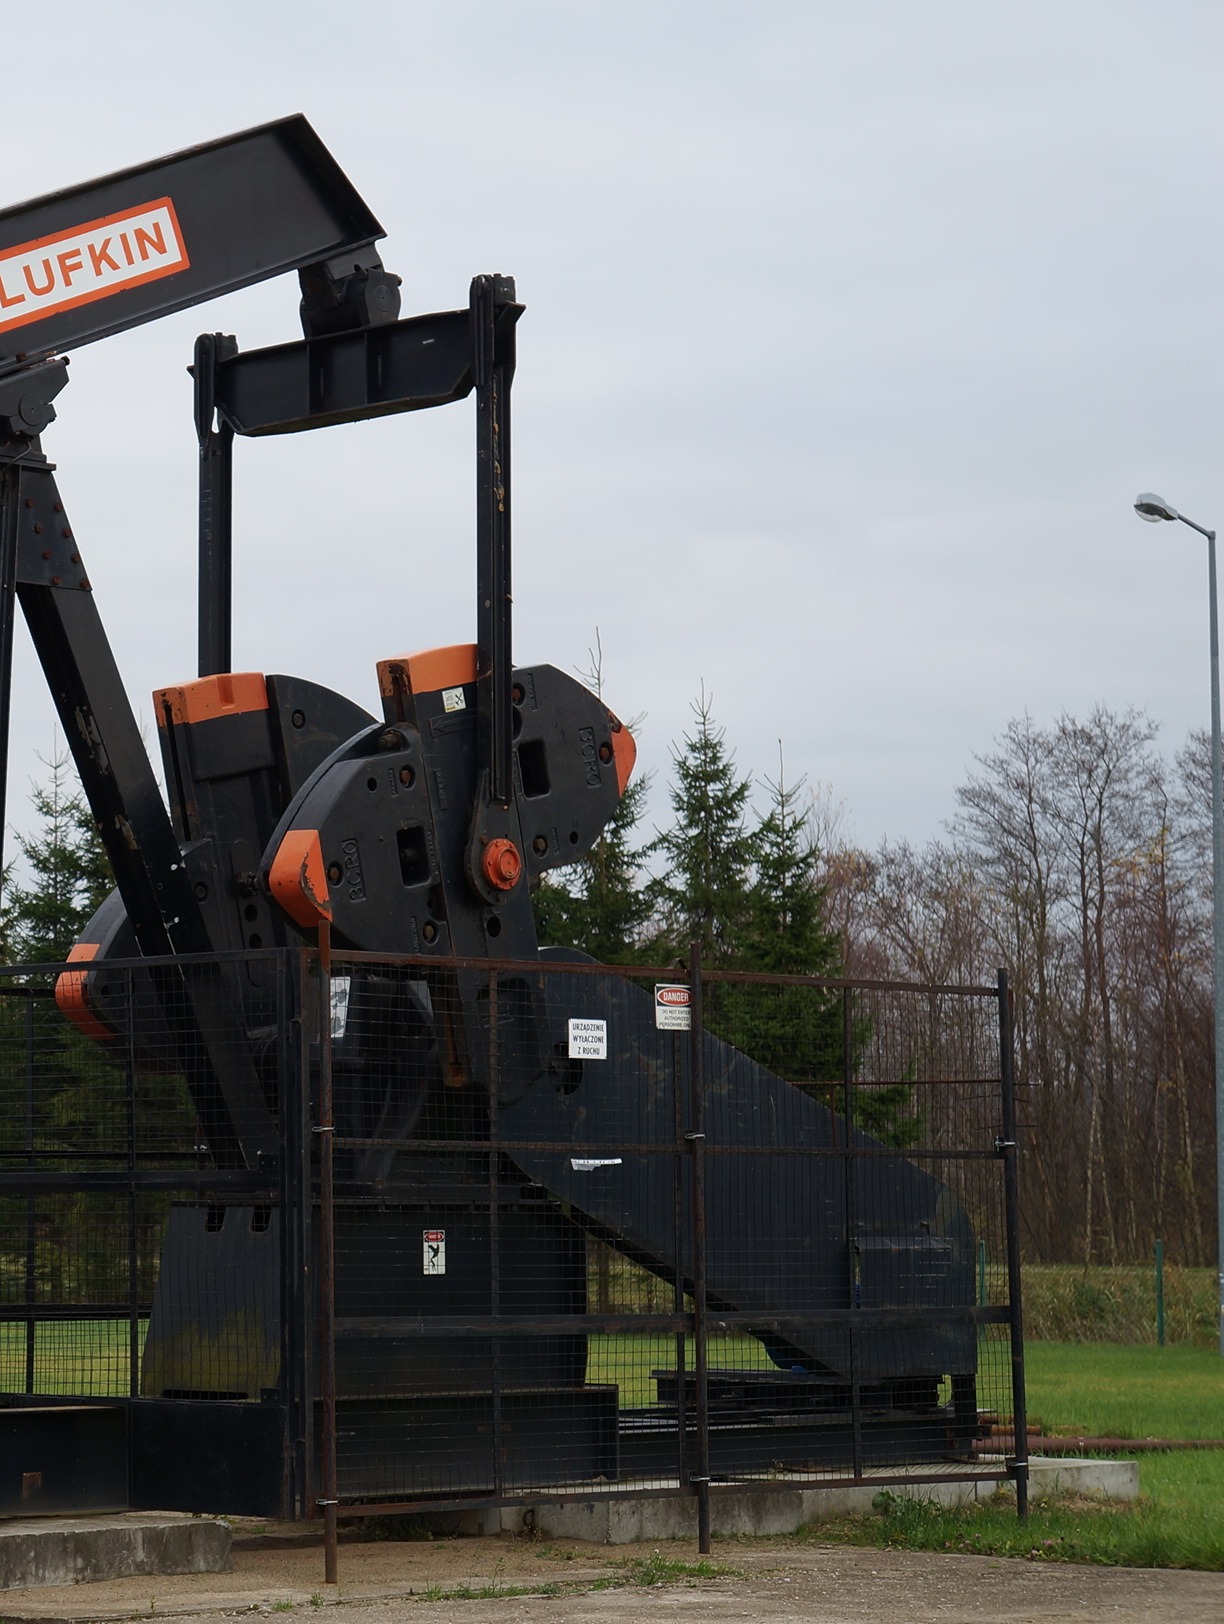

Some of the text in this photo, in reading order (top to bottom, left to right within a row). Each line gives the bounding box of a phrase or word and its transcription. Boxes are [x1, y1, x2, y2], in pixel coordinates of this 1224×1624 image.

[663, 991, 689, 1002] DANGER
[572, 1023, 604, 1033] URZĄDZENIE
[572, 1035, 604, 1045] WYŁĄCZONE
[577, 1046, 601, 1056] Z RUCHU
